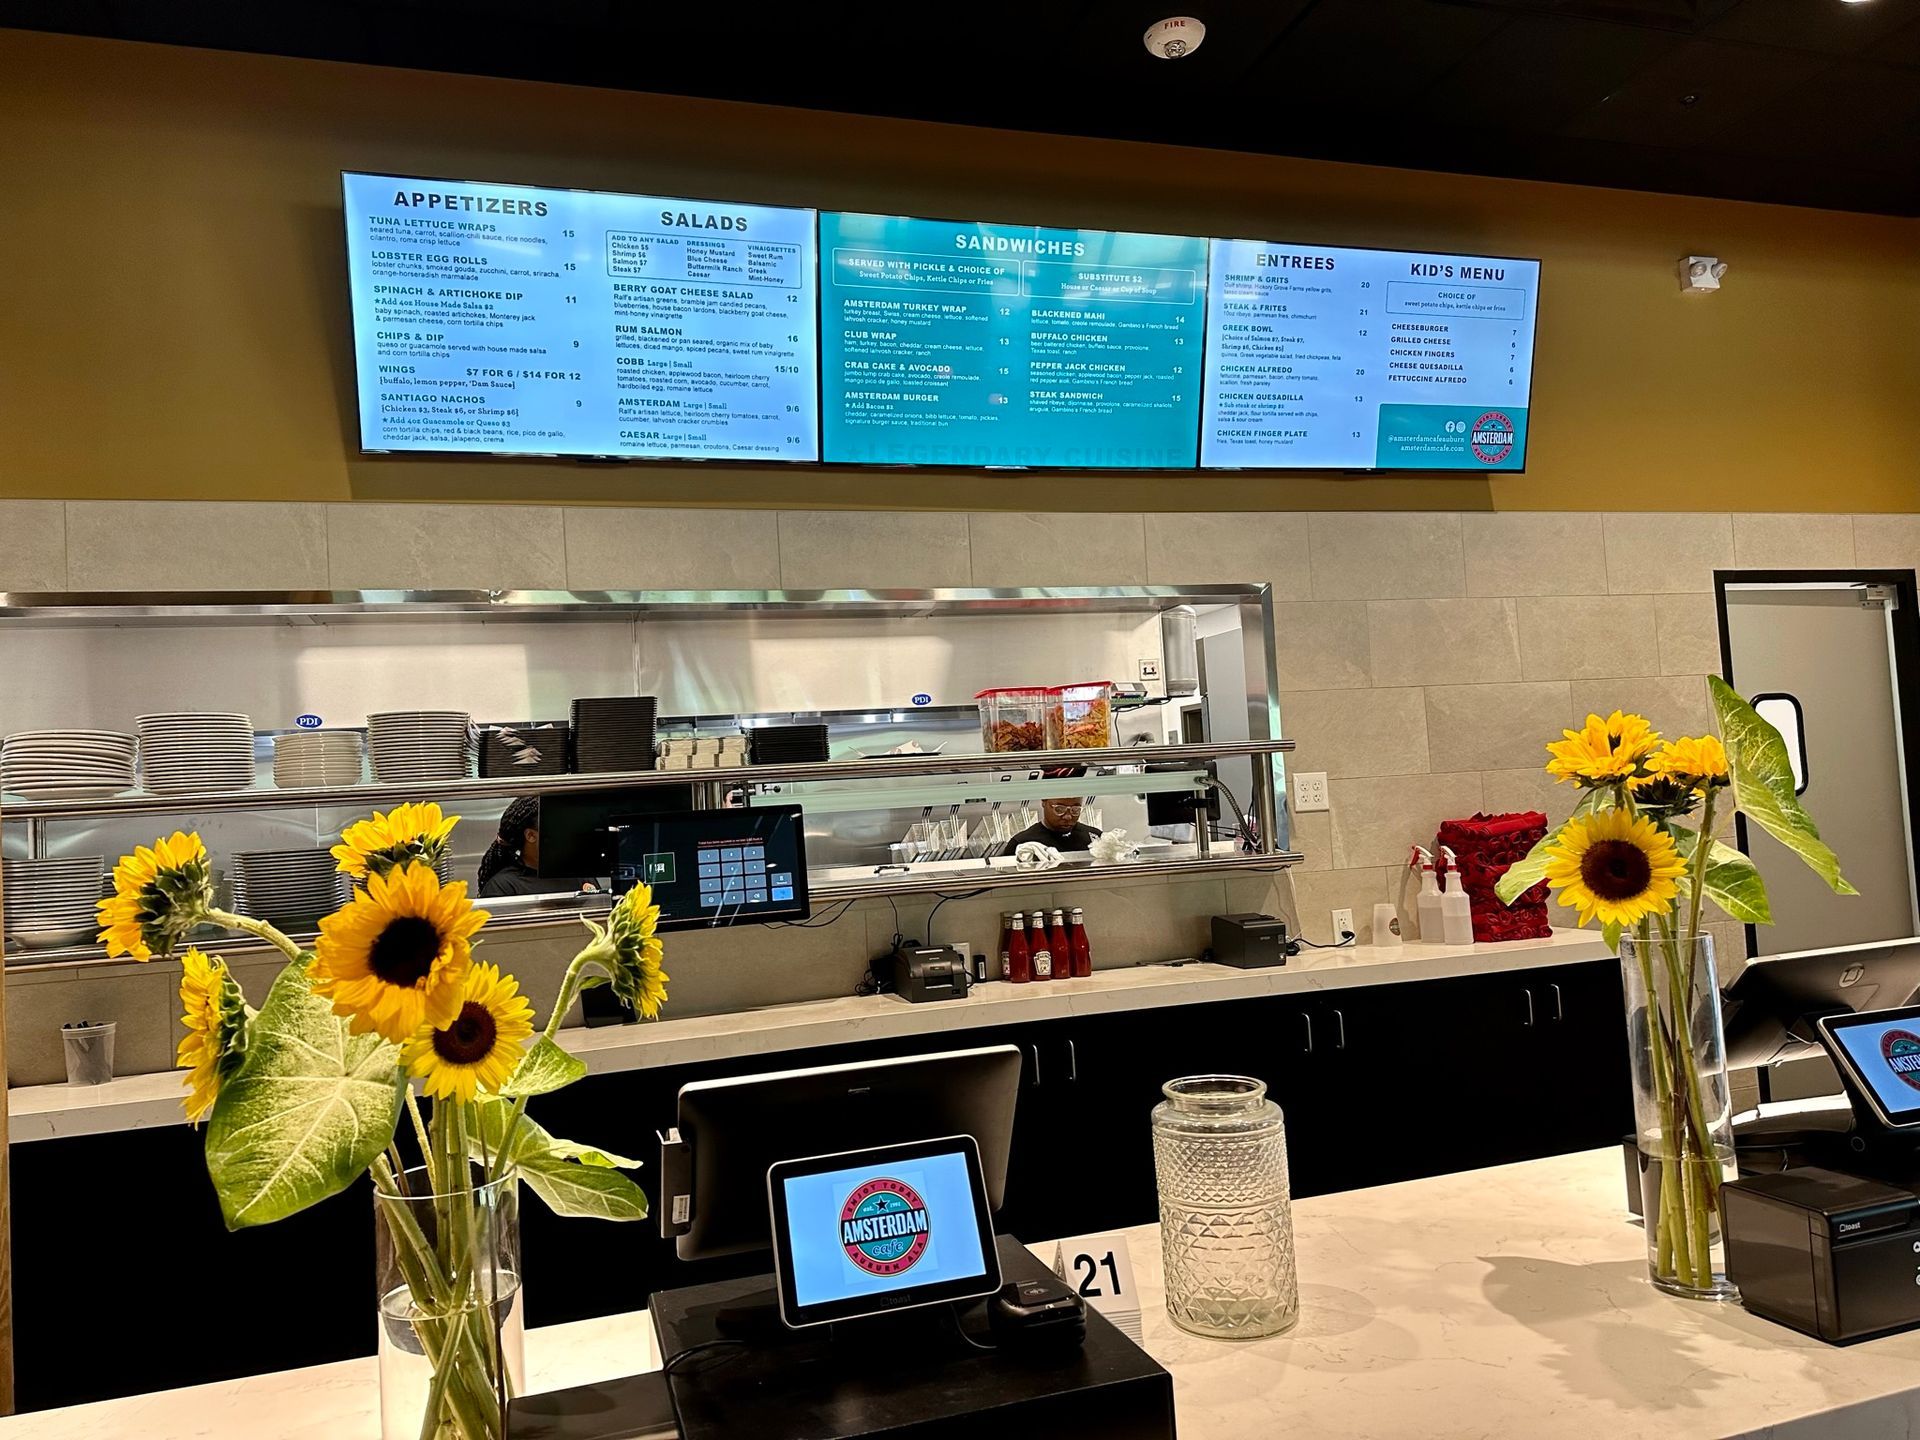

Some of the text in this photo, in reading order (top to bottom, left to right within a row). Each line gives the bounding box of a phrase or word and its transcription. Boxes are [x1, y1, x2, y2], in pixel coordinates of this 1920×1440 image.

[1164, 20, 1185, 29] FIRE
[394, 192, 547, 217] APPETIZERS
[369, 216, 496, 232] TUNA LETTUCE WRAPS
[661, 212, 748, 232] SALADS
[955, 234, 1085, 256] SANDWICHES
[372, 251, 487, 265] LOBSTER EGG ROLLS
[1258, 254, 1335, 270] ENTREES
[849, 259, 884, 268] SERVED
[888, 261, 910, 269] WITH
[914, 263, 945, 272] PICKLE
[957, 265, 991, 275] CHOICE
[994, 267, 1005, 276] OF
[1411, 264, 1504, 281] KID'S MENU
[1079, 273, 1130, 282] SUBSTITUTE
[374, 286, 423, 295] SPINACH
[439, 289, 502, 300] ARTICHOKE
[506, 290, 523, 300] DIP
[614, 284, 753, 300] BERRY GOAT CHEESE SALAD
[844, 300, 966, 313] AMSTERDAM TURKEY WRAP
[1032, 310, 1081, 318] BLACKENED
[641, 327, 682, 336] SALMON
[1391, 324, 1448, 332] CHEESEBURGER
[377, 332, 410, 340] CHIPS
[1031, 333, 1107, 342] BUFFALO CHICKEN
[617, 358, 644, 366] COBB
[909, 364, 951, 373] AVOCADO
[379, 365, 415, 374] WINGS
[482, 369, 504, 377] FOR
[545, 372, 565, 380] FOR
[381, 394, 485, 404] SANTIAGO NACHOS
[618, 398, 680, 407] AMSTERDAM
[845, 392, 900, 400] AMSTERDAM
[1472, 431, 1513, 444] AMSTERDAM
[848, 1182, 918, 1212] ENJOY TODAY
[844, 1209, 928, 1244] AMSTERDAM
[872, 1238, 904, 1257] cafe
[852, 1242, 923, 1272] AUBURN ALA
[1074, 1251, 1121, 1298] 21
